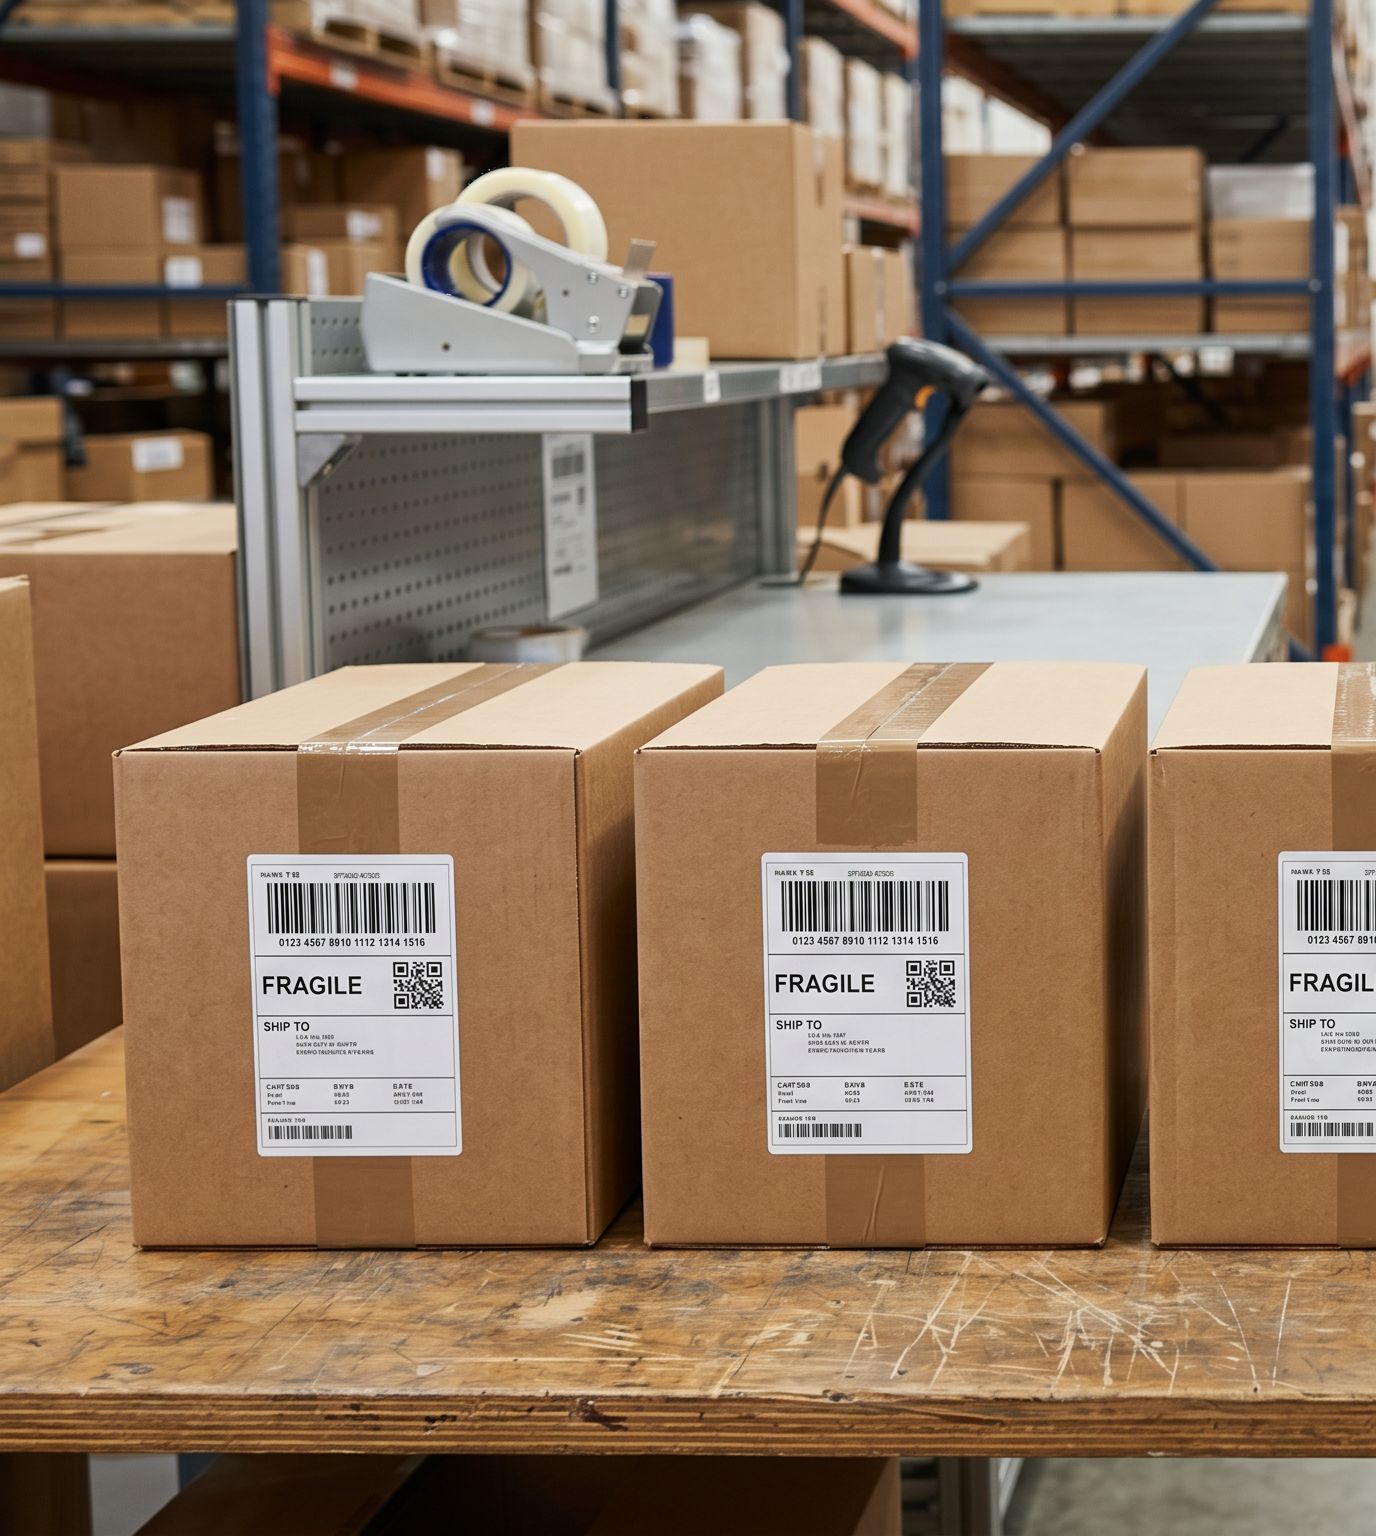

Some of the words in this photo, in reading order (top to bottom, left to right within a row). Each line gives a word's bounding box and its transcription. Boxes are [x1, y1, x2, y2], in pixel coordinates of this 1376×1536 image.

[304, 938, 325, 946] 4567
[329, 938, 351, 946] 8910
[379, 938, 400, 946] 1314
[404, 938, 425, 946] 1516
[793, 937, 814, 945] 0123
[818, 937, 839, 945] 4567
[843, 937, 864, 945] 8910
[1308, 936, 1329, 944] 0123
[1333, 936, 1354, 944] 4567
[263, 976, 362, 994] FRAGILE
[776, 974, 874, 993] FRAGILE
[264, 1022, 290, 1031] SHIP
[294, 1022, 309, 1031] TO
[777, 1020, 802, 1030] SHIP
[807, 1020, 821, 1029] TO
[1290, 1019, 1316, 1028] SHIP
[1320, 1019, 1335, 1028] TO
